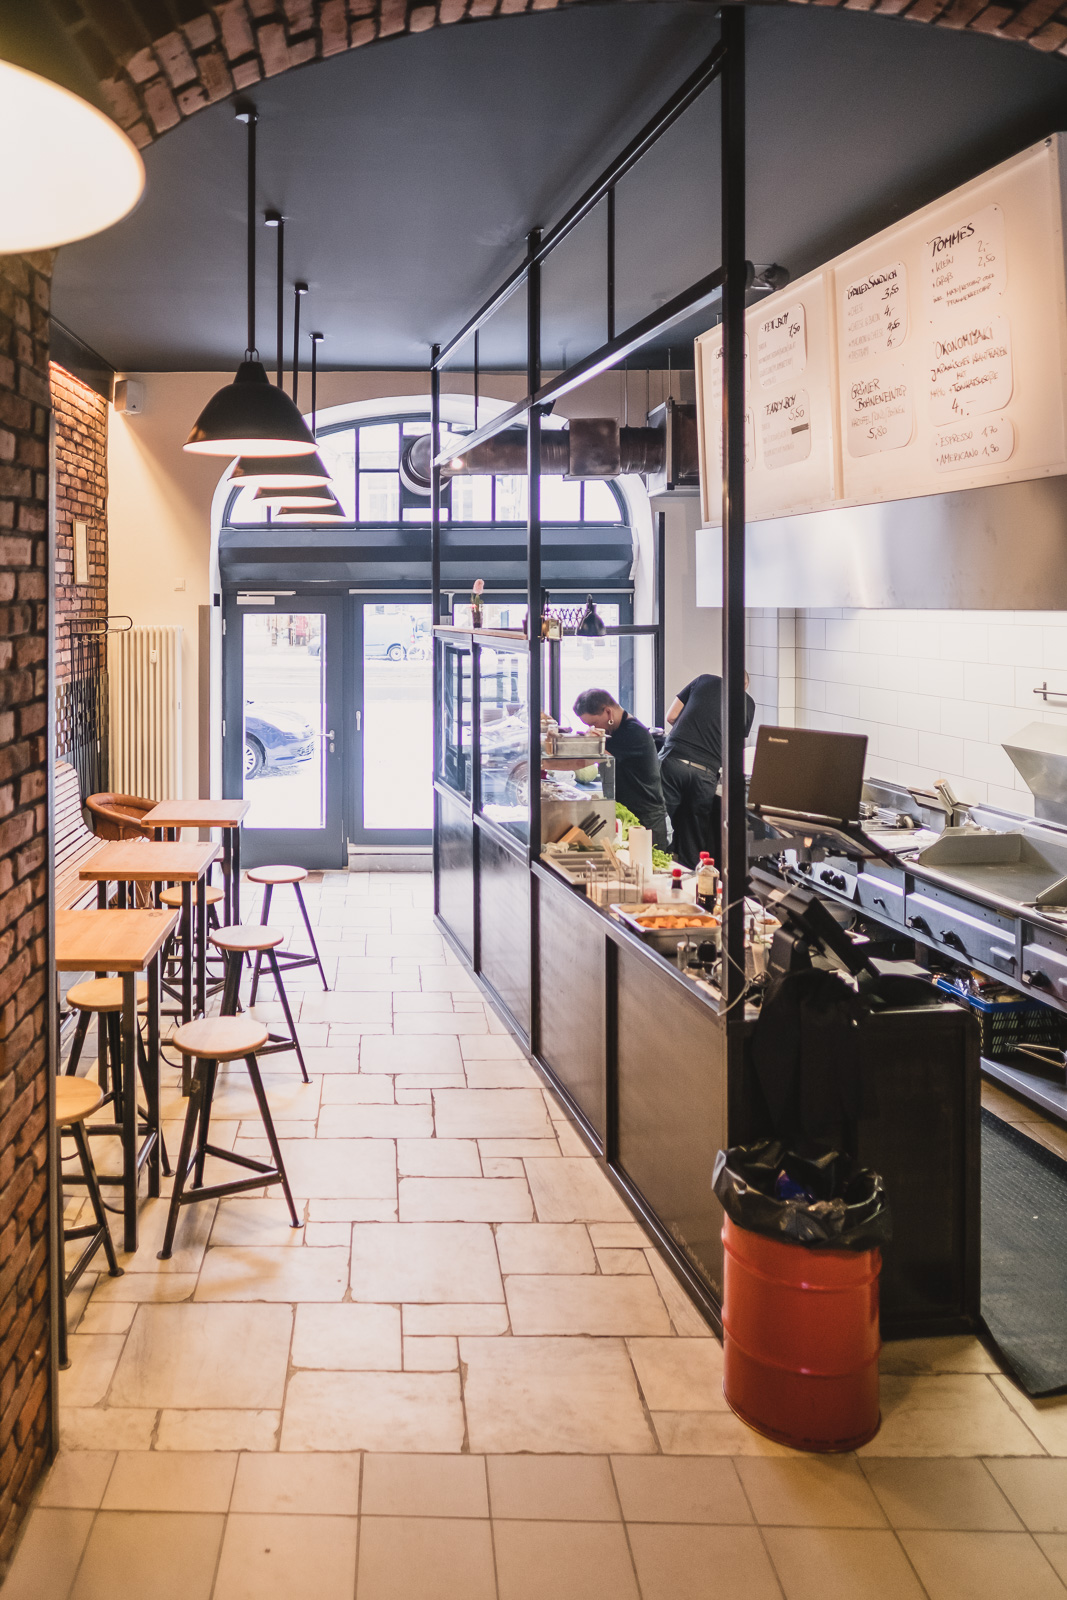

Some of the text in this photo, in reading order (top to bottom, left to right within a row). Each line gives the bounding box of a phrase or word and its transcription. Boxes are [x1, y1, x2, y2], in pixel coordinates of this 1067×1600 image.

[928, 222, 975, 257] POMMES
[940, 430, 973, 448] ESPRESSO
[940, 448, 979, 466] AMERICANO
